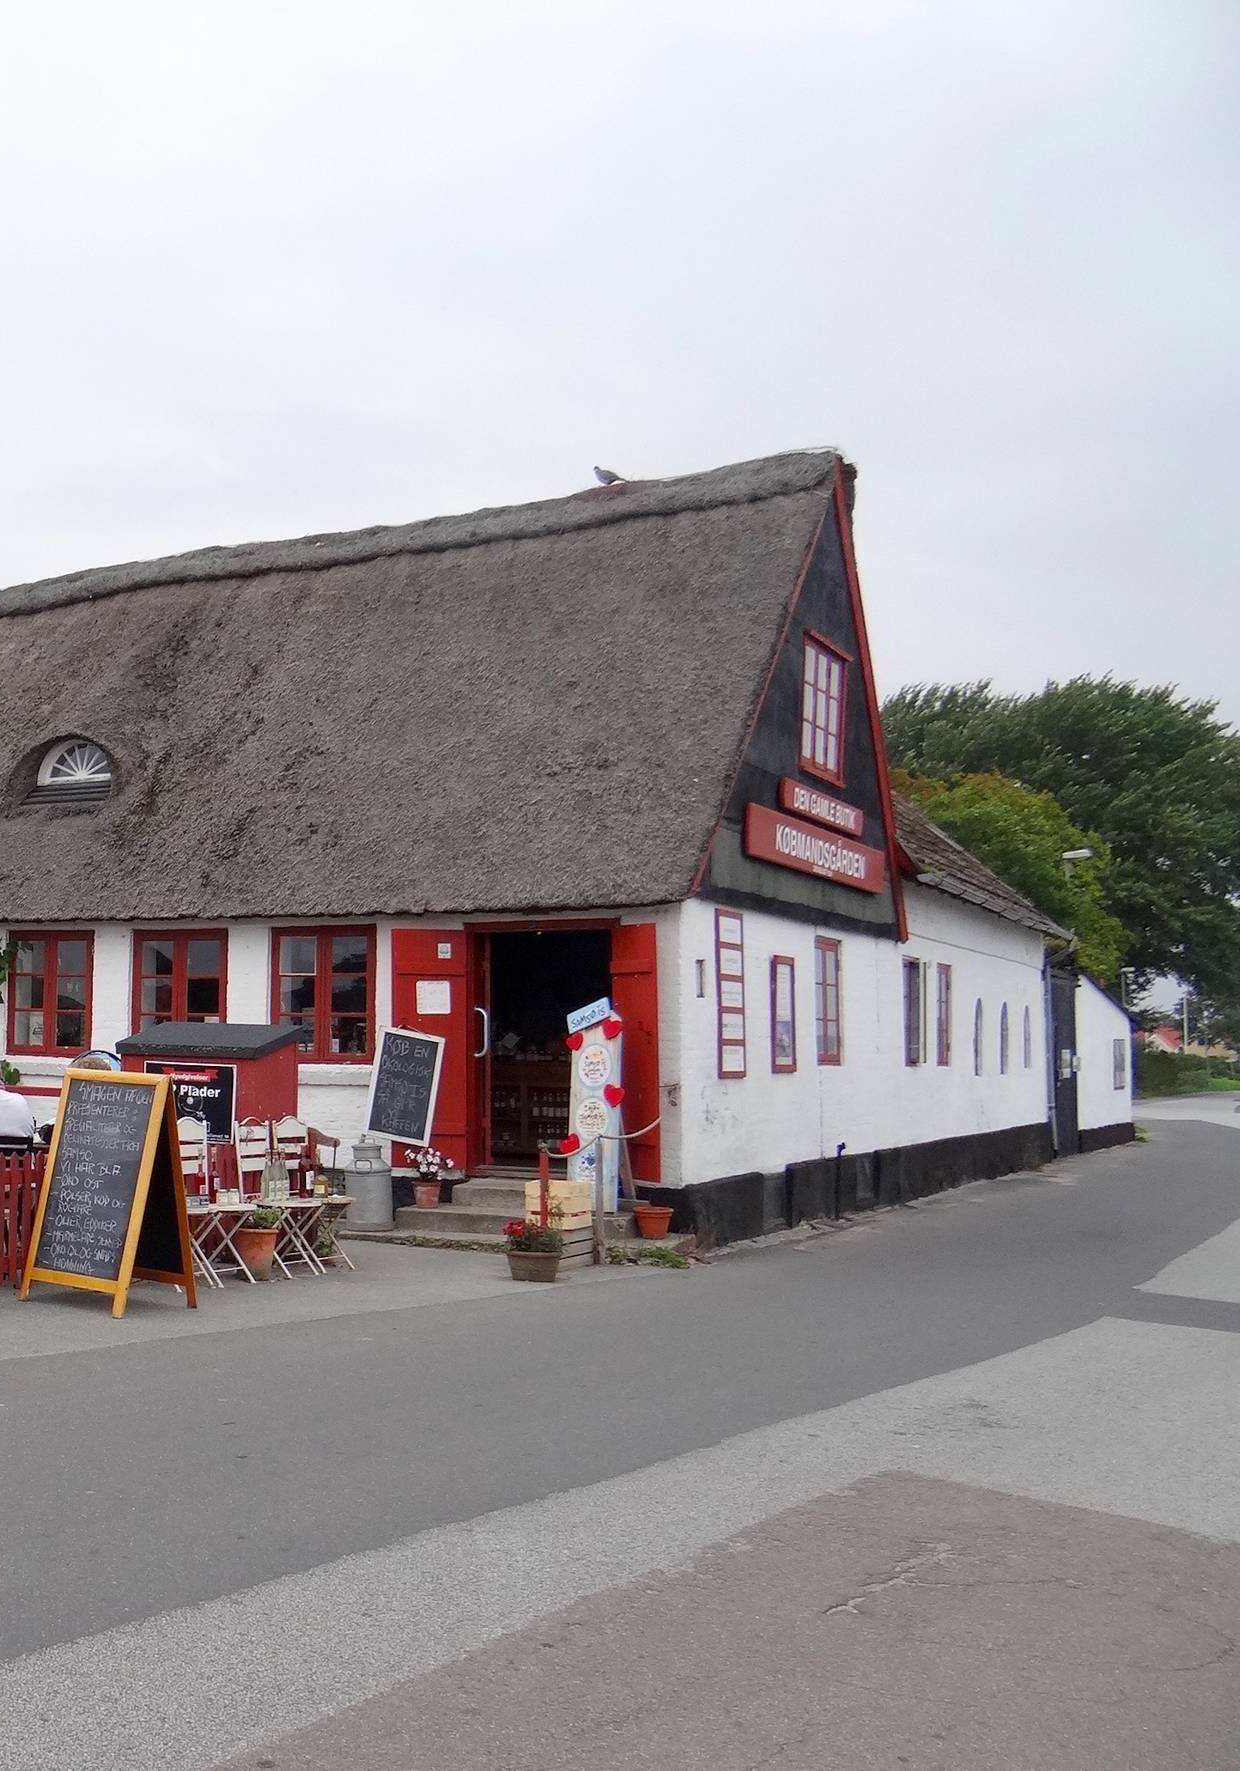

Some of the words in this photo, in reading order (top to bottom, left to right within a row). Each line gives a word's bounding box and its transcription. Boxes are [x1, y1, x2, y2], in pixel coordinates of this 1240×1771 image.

[794, 787, 810, 811] DEN
[810, 794, 836, 822] GAMLE
[835, 805, 856, 830] BUTIK
[776, 824, 865, 879] KØBMANDSGÅRDEN
[386, 1035, 410, 1057] KØB
[414, 1045, 430, 1059] EN
[180, 1084, 221, 1098] Plader
[75, 1162, 95, 1175] HAR
